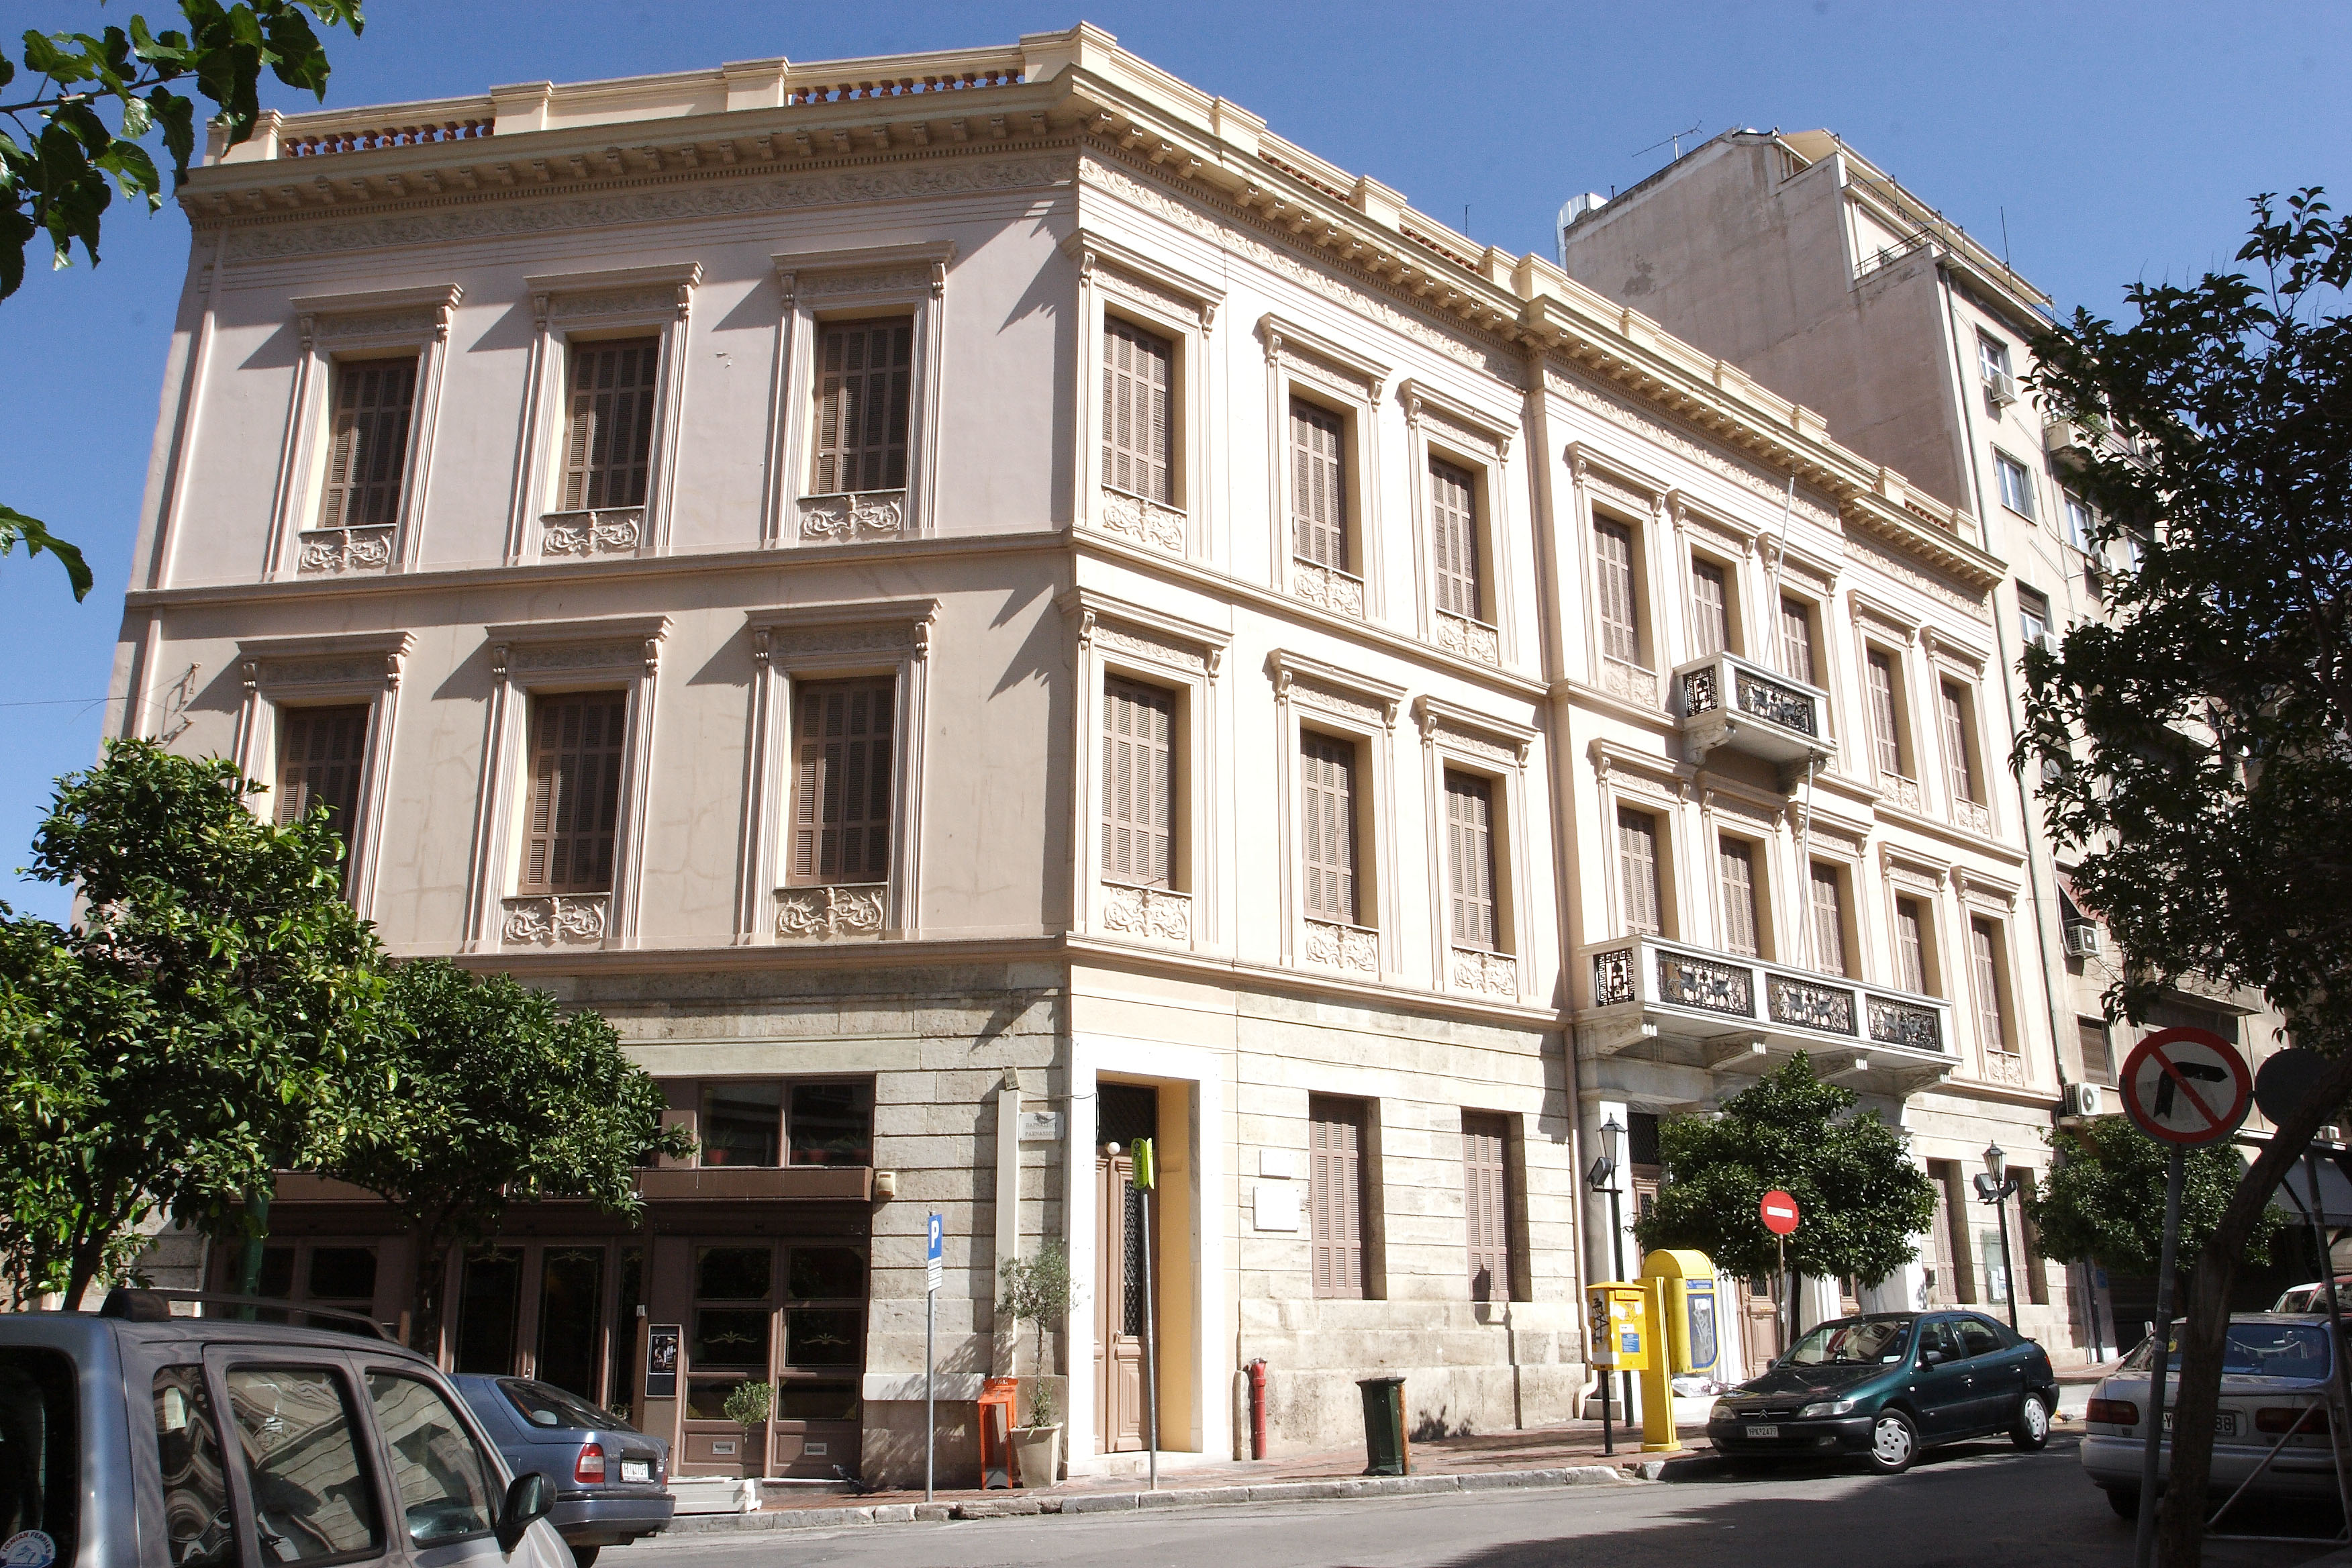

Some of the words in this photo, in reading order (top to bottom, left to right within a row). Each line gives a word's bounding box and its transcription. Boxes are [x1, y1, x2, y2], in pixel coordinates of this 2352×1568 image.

[931, 1220, 939, 1248] P
[2, 1532, 29, 1552] IONIAN
[30, 1532, 52, 1554] FERRIES
